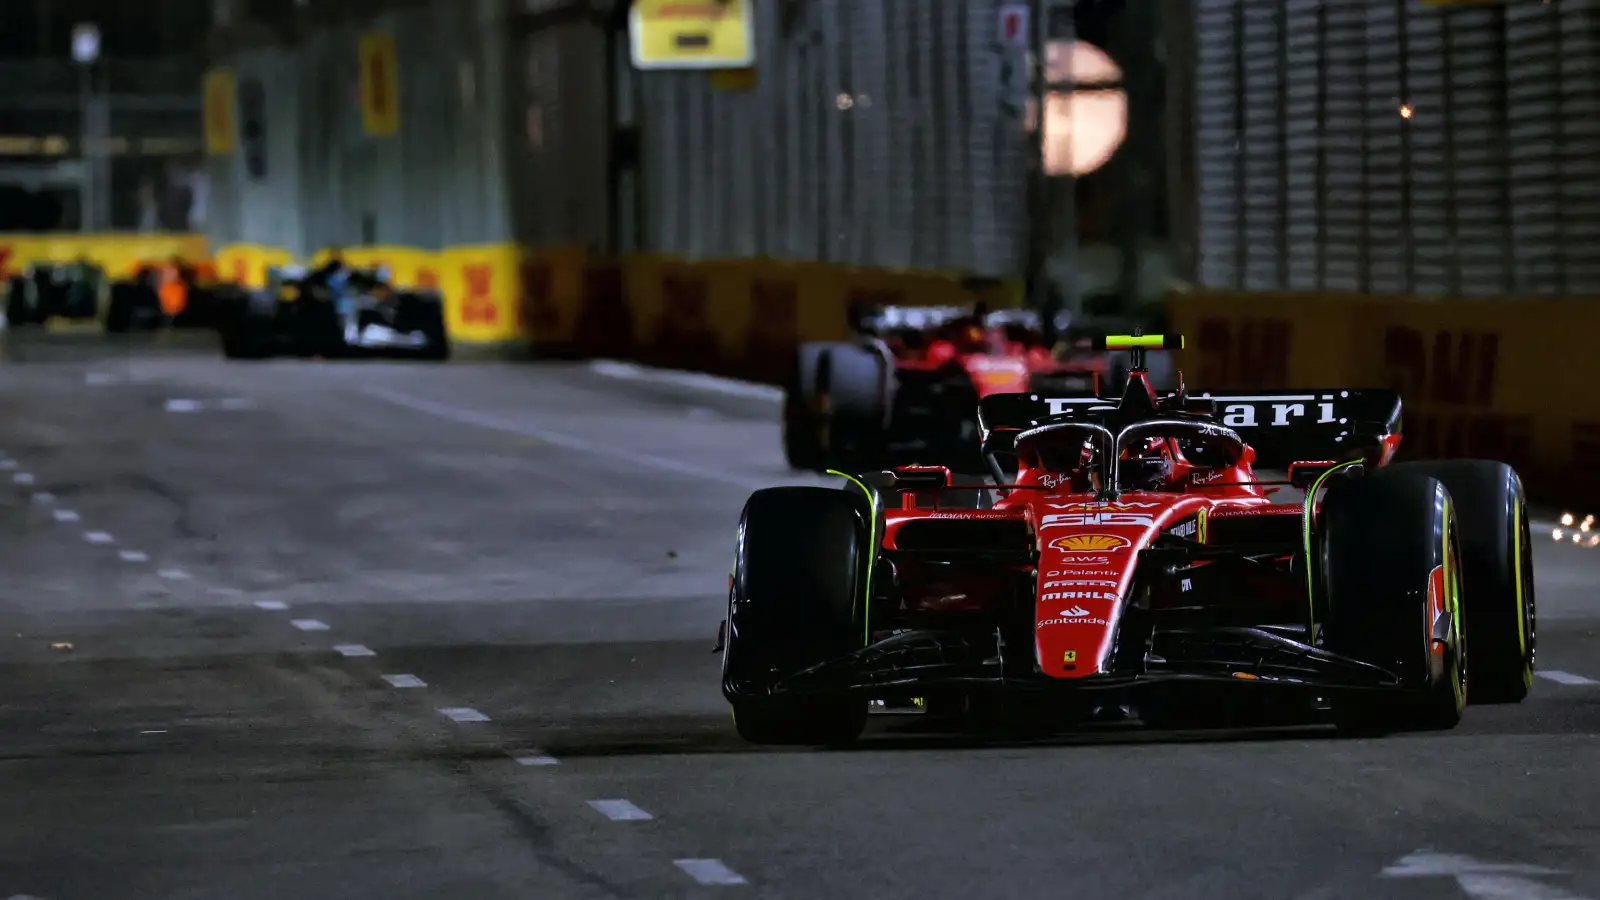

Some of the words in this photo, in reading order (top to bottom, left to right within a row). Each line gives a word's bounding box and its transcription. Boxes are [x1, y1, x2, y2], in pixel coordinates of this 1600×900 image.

[1044, 394, 1337, 428] Fari
[1191, 469, 1224, 485] Ray-Ban
[1041, 591, 1117, 602] MAHLE
